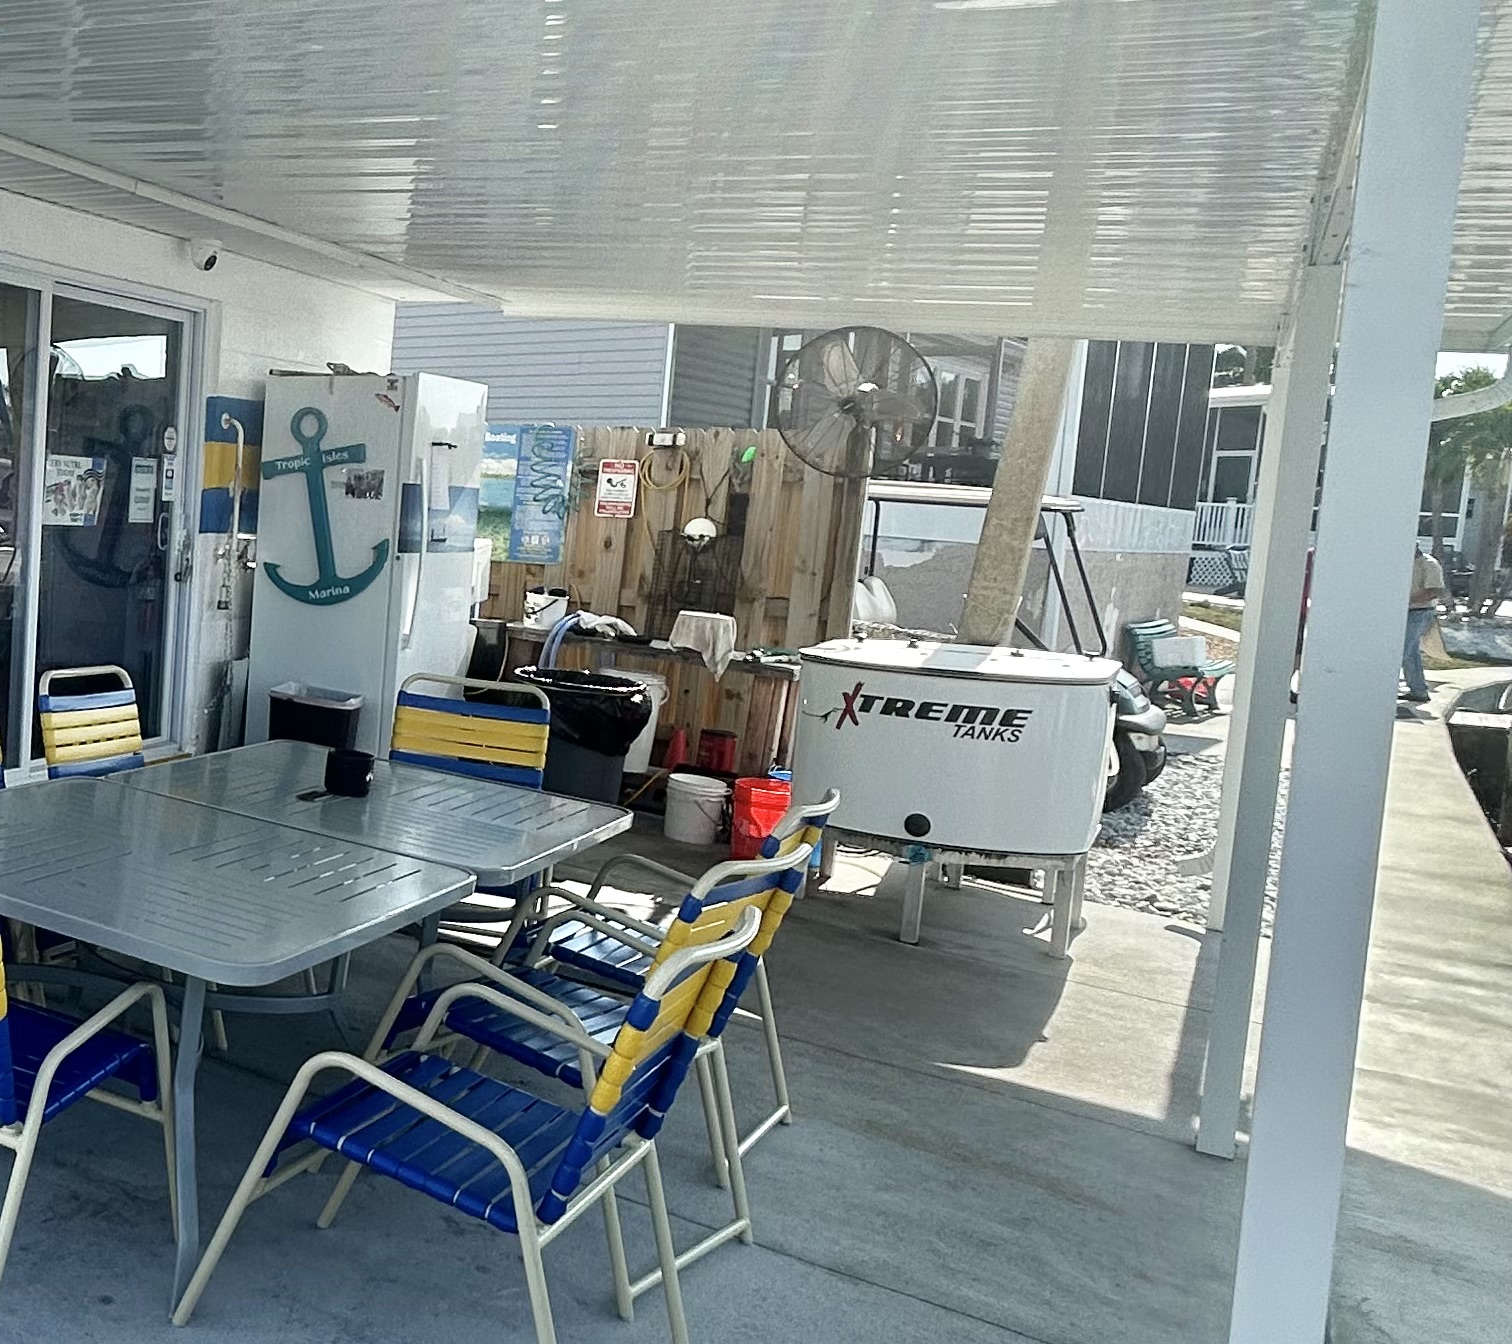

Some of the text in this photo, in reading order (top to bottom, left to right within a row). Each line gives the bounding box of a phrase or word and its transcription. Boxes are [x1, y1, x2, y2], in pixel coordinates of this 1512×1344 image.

[275, 450, 349, 471] Tropic Isles
[308, 585, 350, 600] Marina
[836, 681, 1033, 730] XTREME
[953, 724, 1023, 743] TANKS
